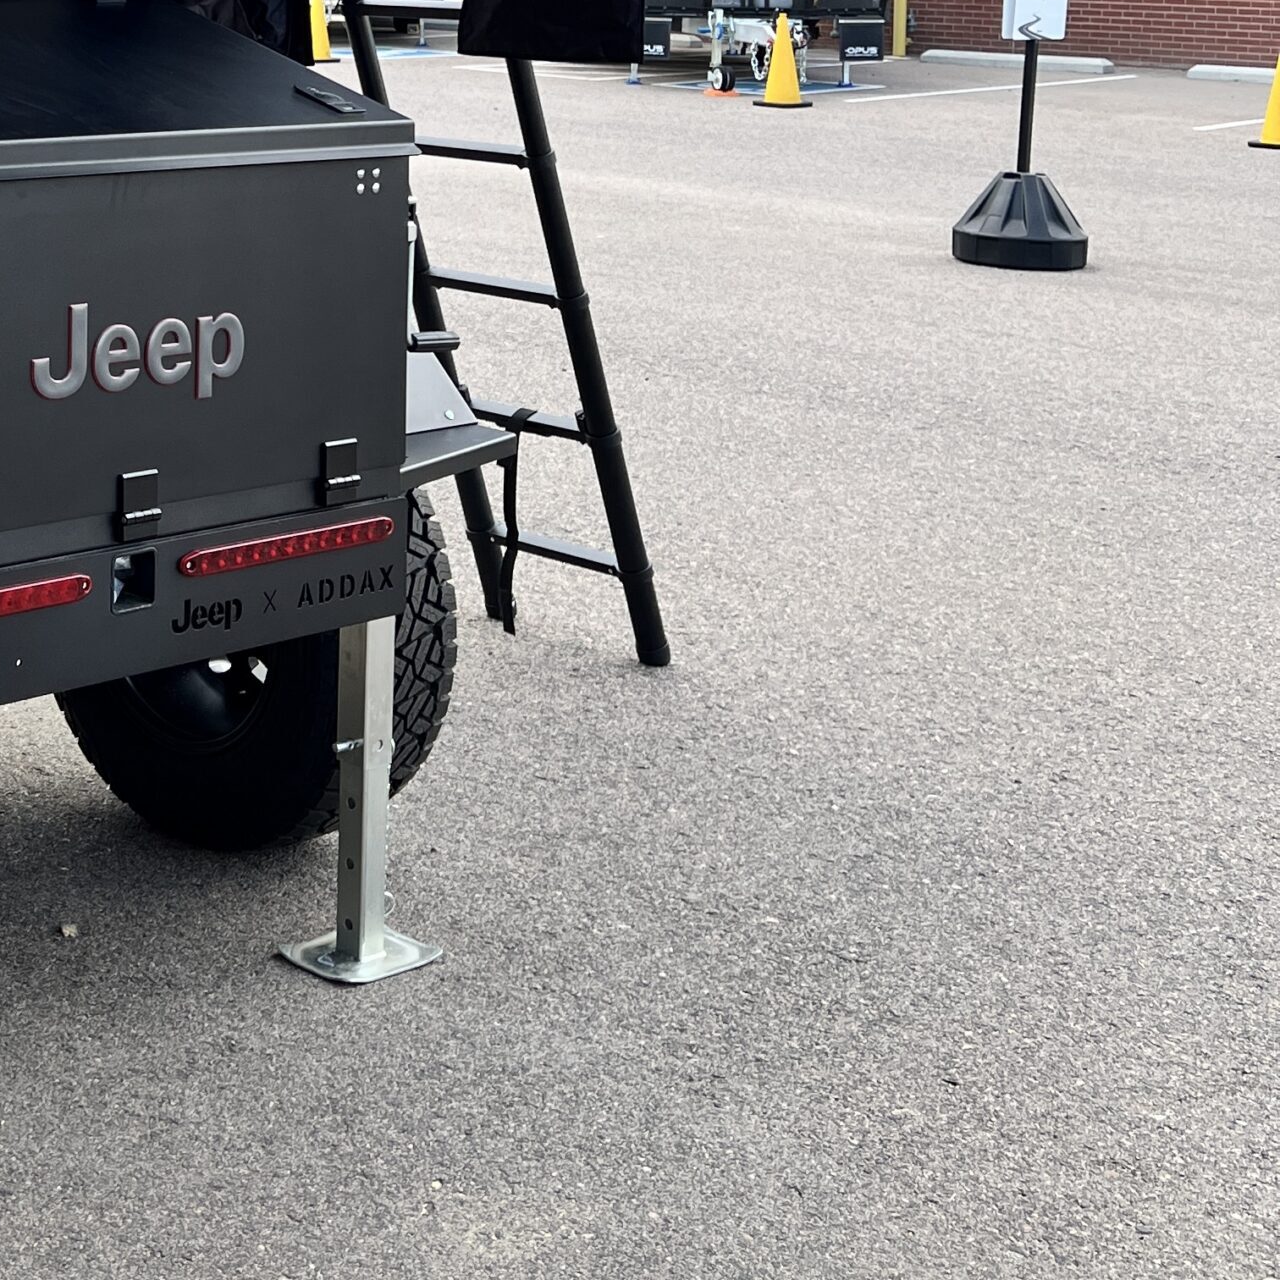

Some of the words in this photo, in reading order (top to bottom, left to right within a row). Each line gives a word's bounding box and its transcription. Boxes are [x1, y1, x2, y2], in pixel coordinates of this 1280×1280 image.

[643, 44, 664, 53] PUS
[30, 302, 246, 400] Jeep
[171, 598, 243, 635] Jeep
[297, 564, 395, 609] ADDAX
